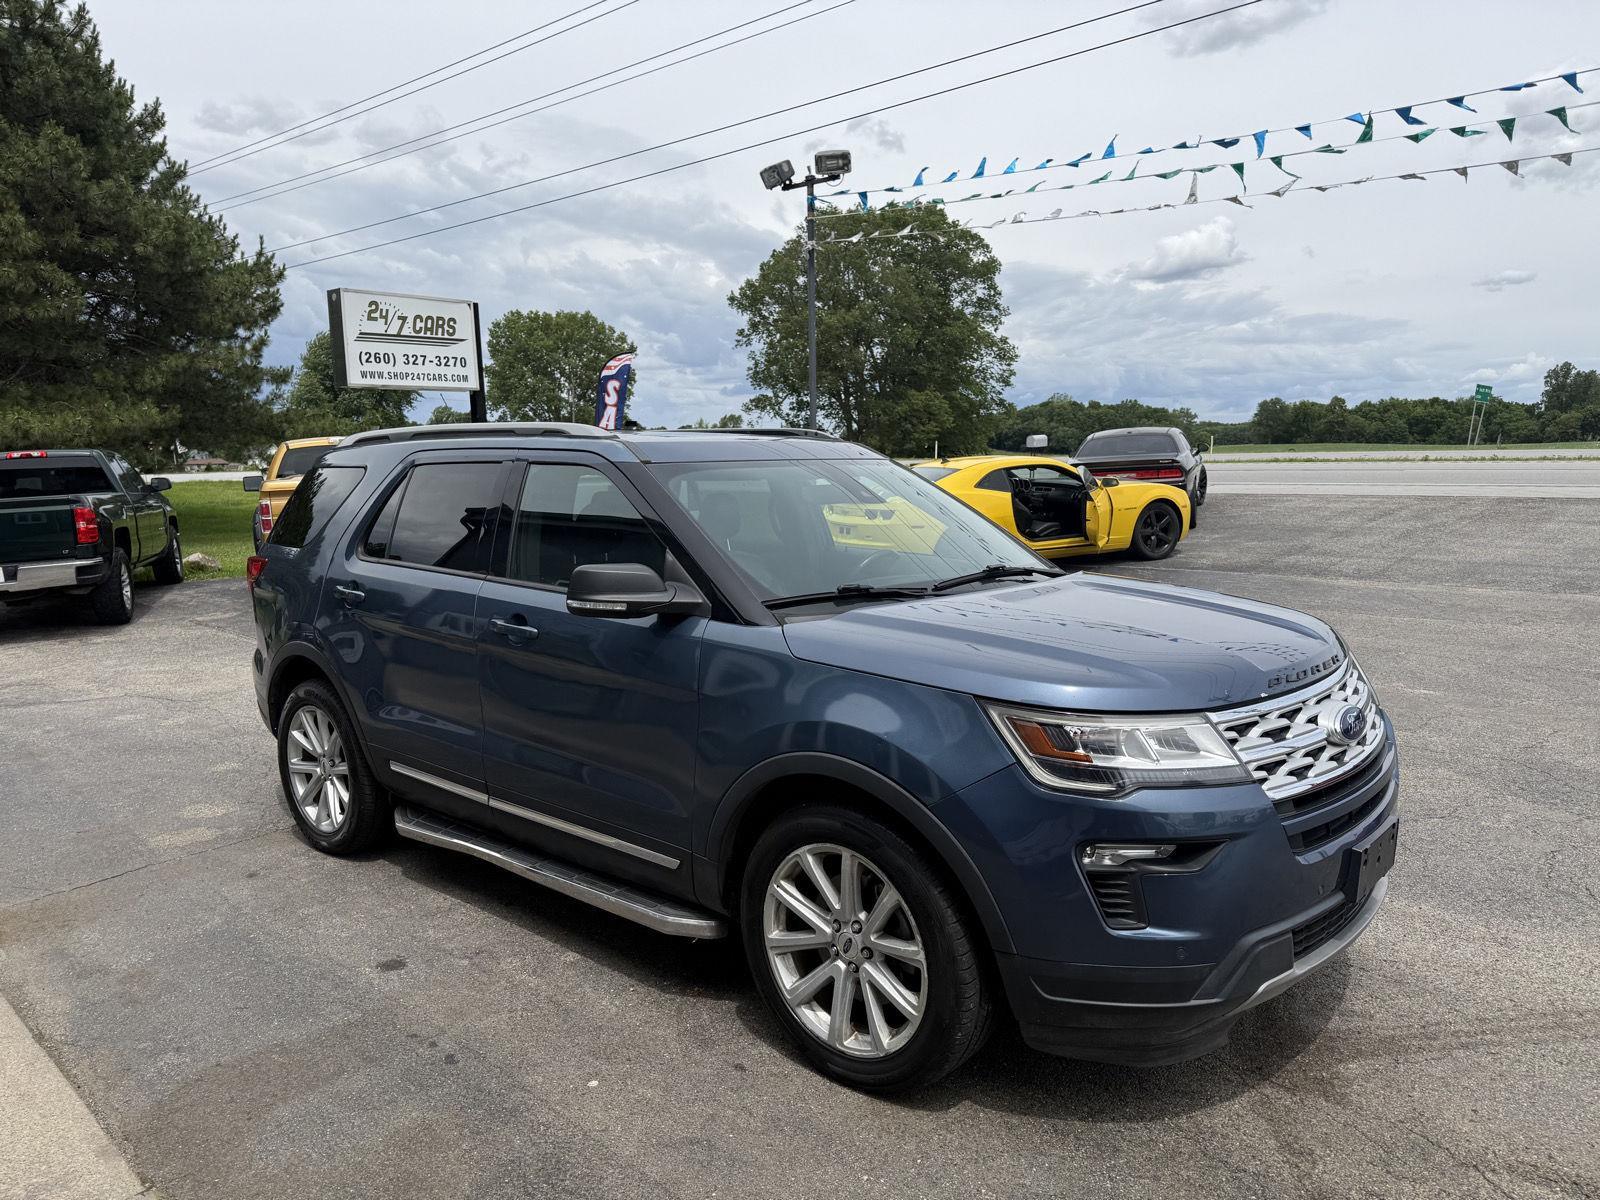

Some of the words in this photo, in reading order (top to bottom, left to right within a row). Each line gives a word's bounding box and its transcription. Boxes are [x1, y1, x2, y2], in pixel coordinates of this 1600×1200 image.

[366, 300, 408, 336] 24/7
[412, 314, 457, 337] CARS
[358, 351, 396, 367] (260)
[402, 353, 467, 368] 327-3270
[359, 370, 469, 383] WWW.SHOP247CARS.COM
